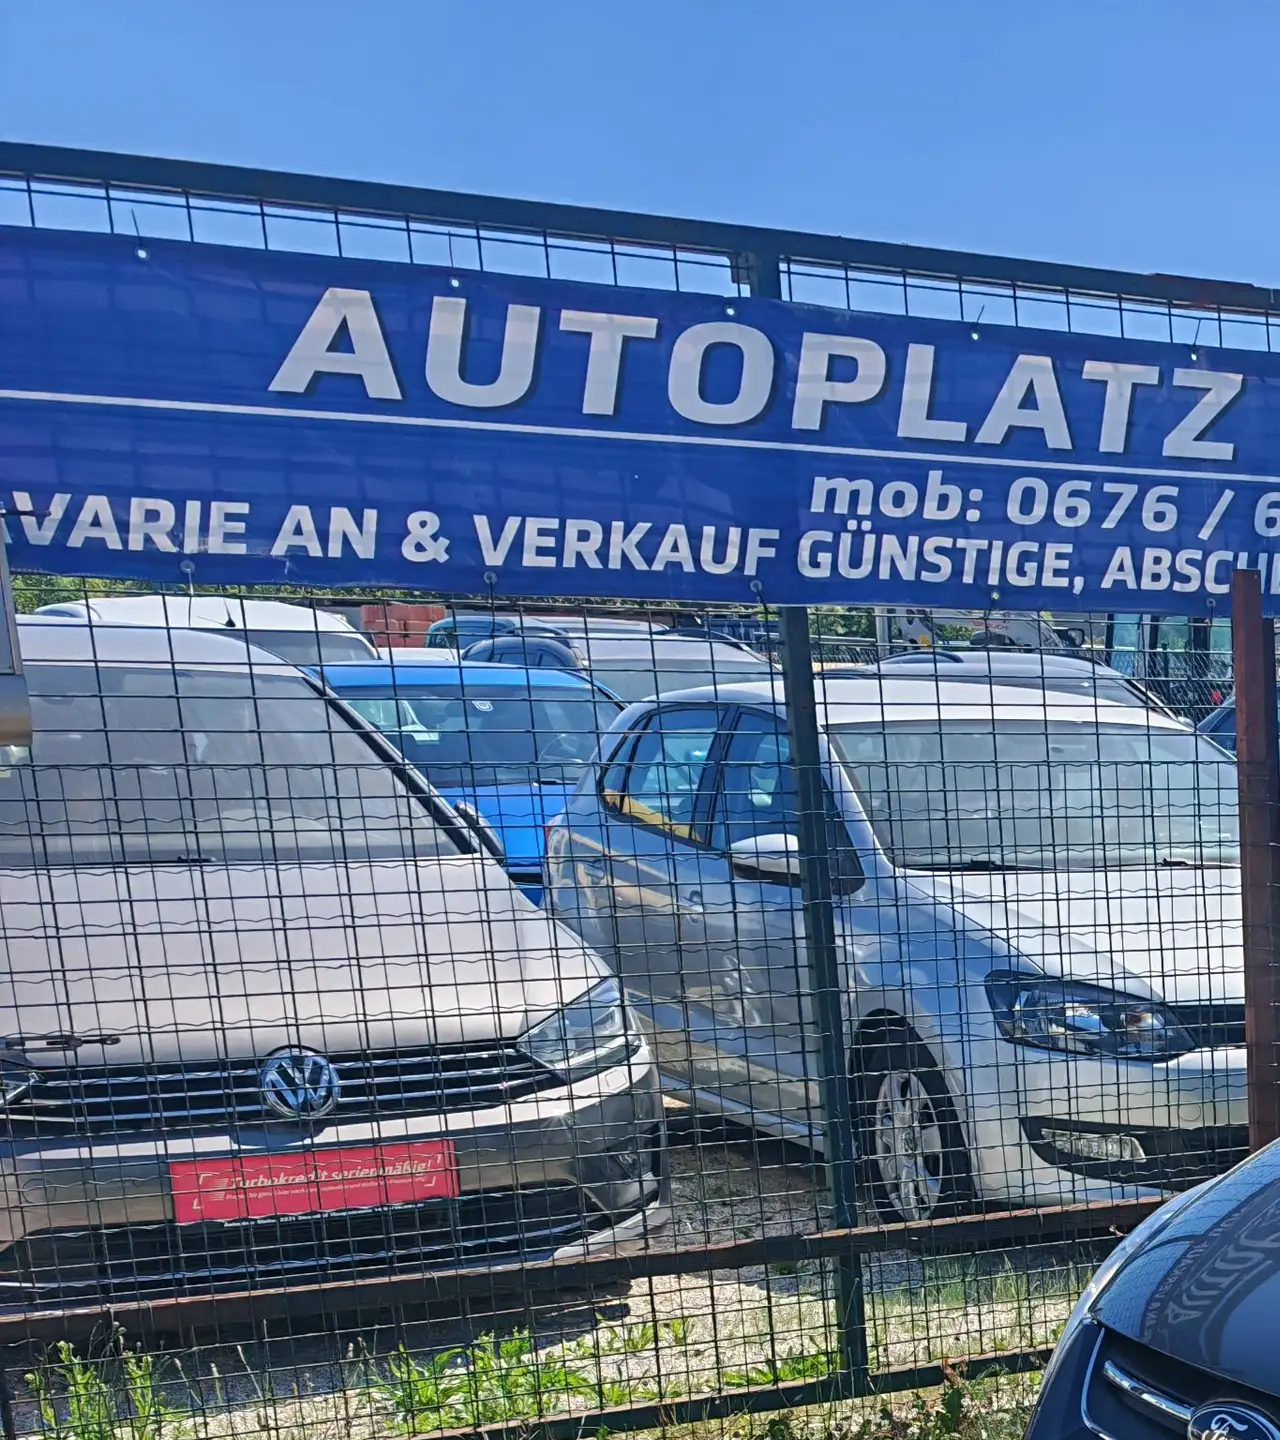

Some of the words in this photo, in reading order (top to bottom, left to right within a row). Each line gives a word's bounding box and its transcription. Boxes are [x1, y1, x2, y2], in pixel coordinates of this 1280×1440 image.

[268, 287, 1244, 461] AUTOPLATZ
[0, 491, 250, 555] VARIE
[269, 505, 378, 560] AN
[401, 511, 451, 564] &
[473, 514, 781, 577] VERKAUF
[810, 470, 983, 522] mob:
[1006, 477, 1179, 533] 0676
[1198, 489, 1236, 541] /
[797, 519, 1086, 596] GÜNSTIGE,
